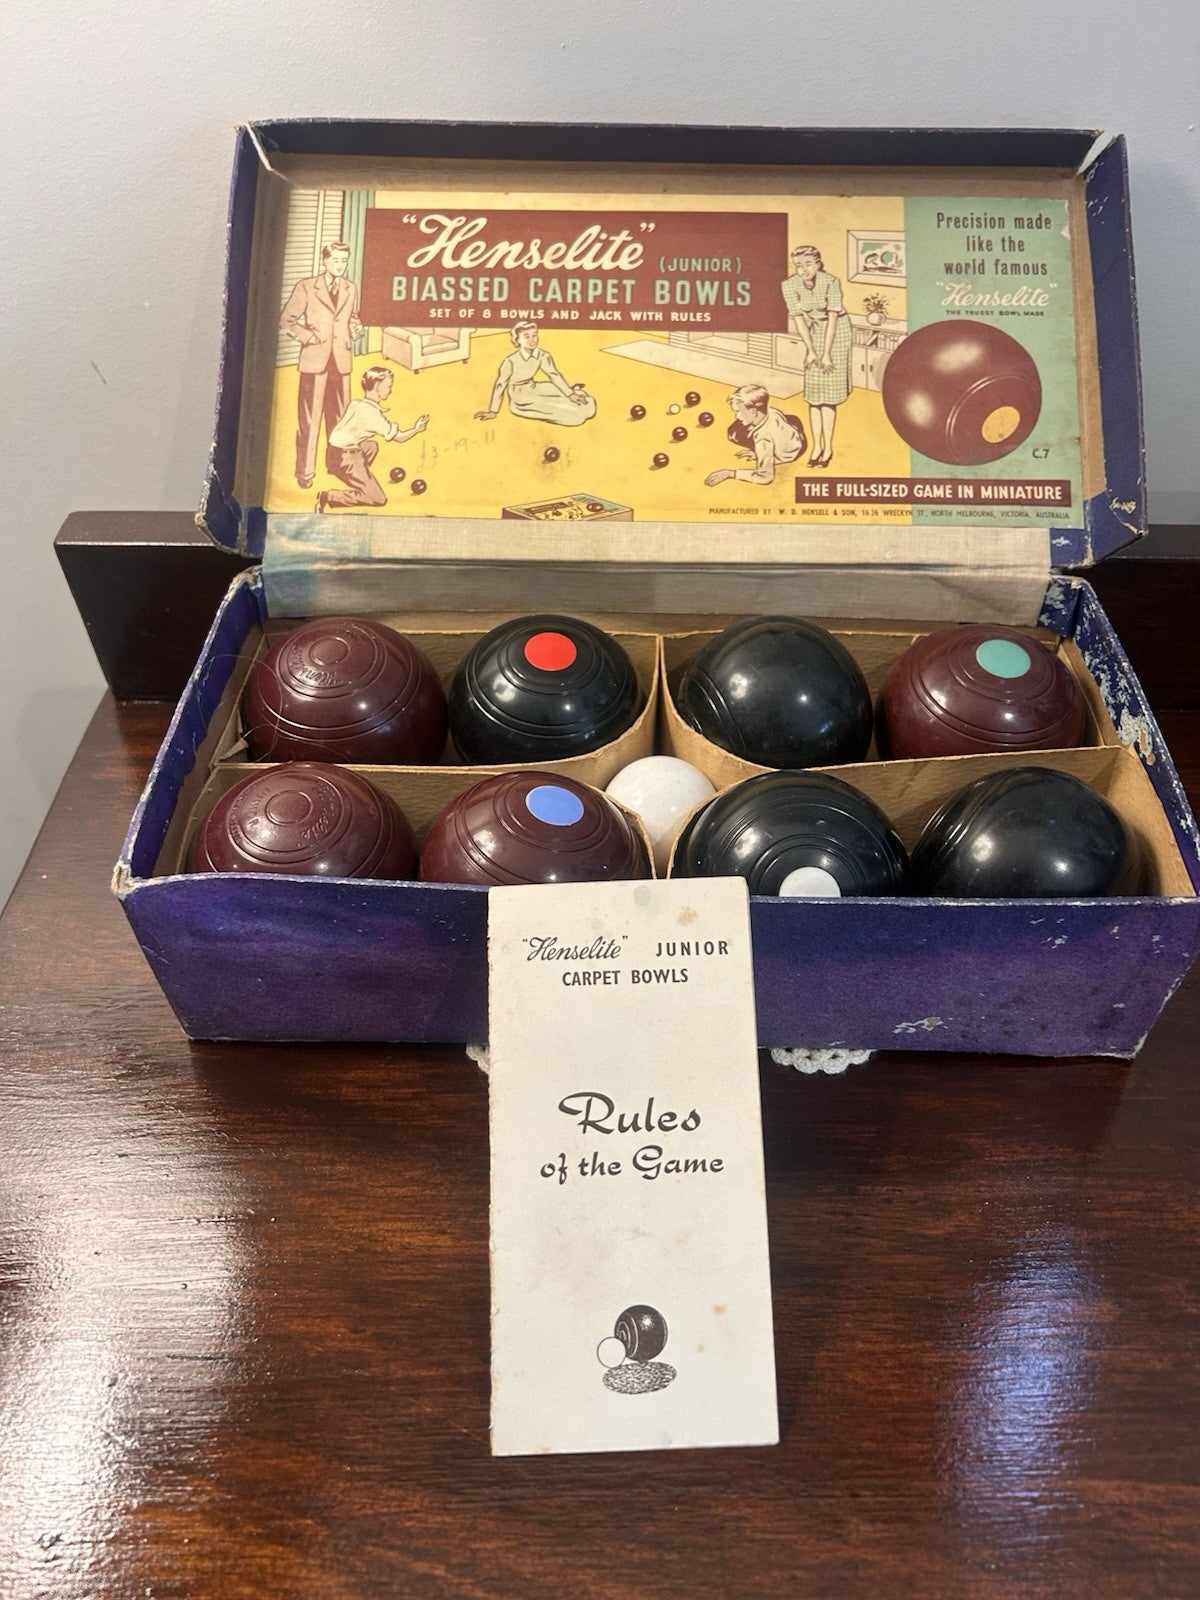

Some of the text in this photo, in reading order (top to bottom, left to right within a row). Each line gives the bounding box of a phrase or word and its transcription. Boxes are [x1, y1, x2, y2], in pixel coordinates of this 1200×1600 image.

[936, 212, 1052, 230] Precision made
[966, 235, 1025, 252] like the
[659, 256, 742, 273] (JUNIOR)
[944, 259, 1048, 275] world famous
[392, 275, 751, 306] BIASSED CARPET BOWLS
[429, 308, 712, 322] SET OF 8 BOWLS AND JACK WITH RULES
[803, 483, 1062, 500] THE FULL-SIZED GAME IN MINIATURE
[656, 940, 729, 957] JUNIOR
[562, 968, 689, 986] CARPET BOWLS
[558, 1091, 702, 1135] Rules
[540, 1144, 725, 1185] of the Game
